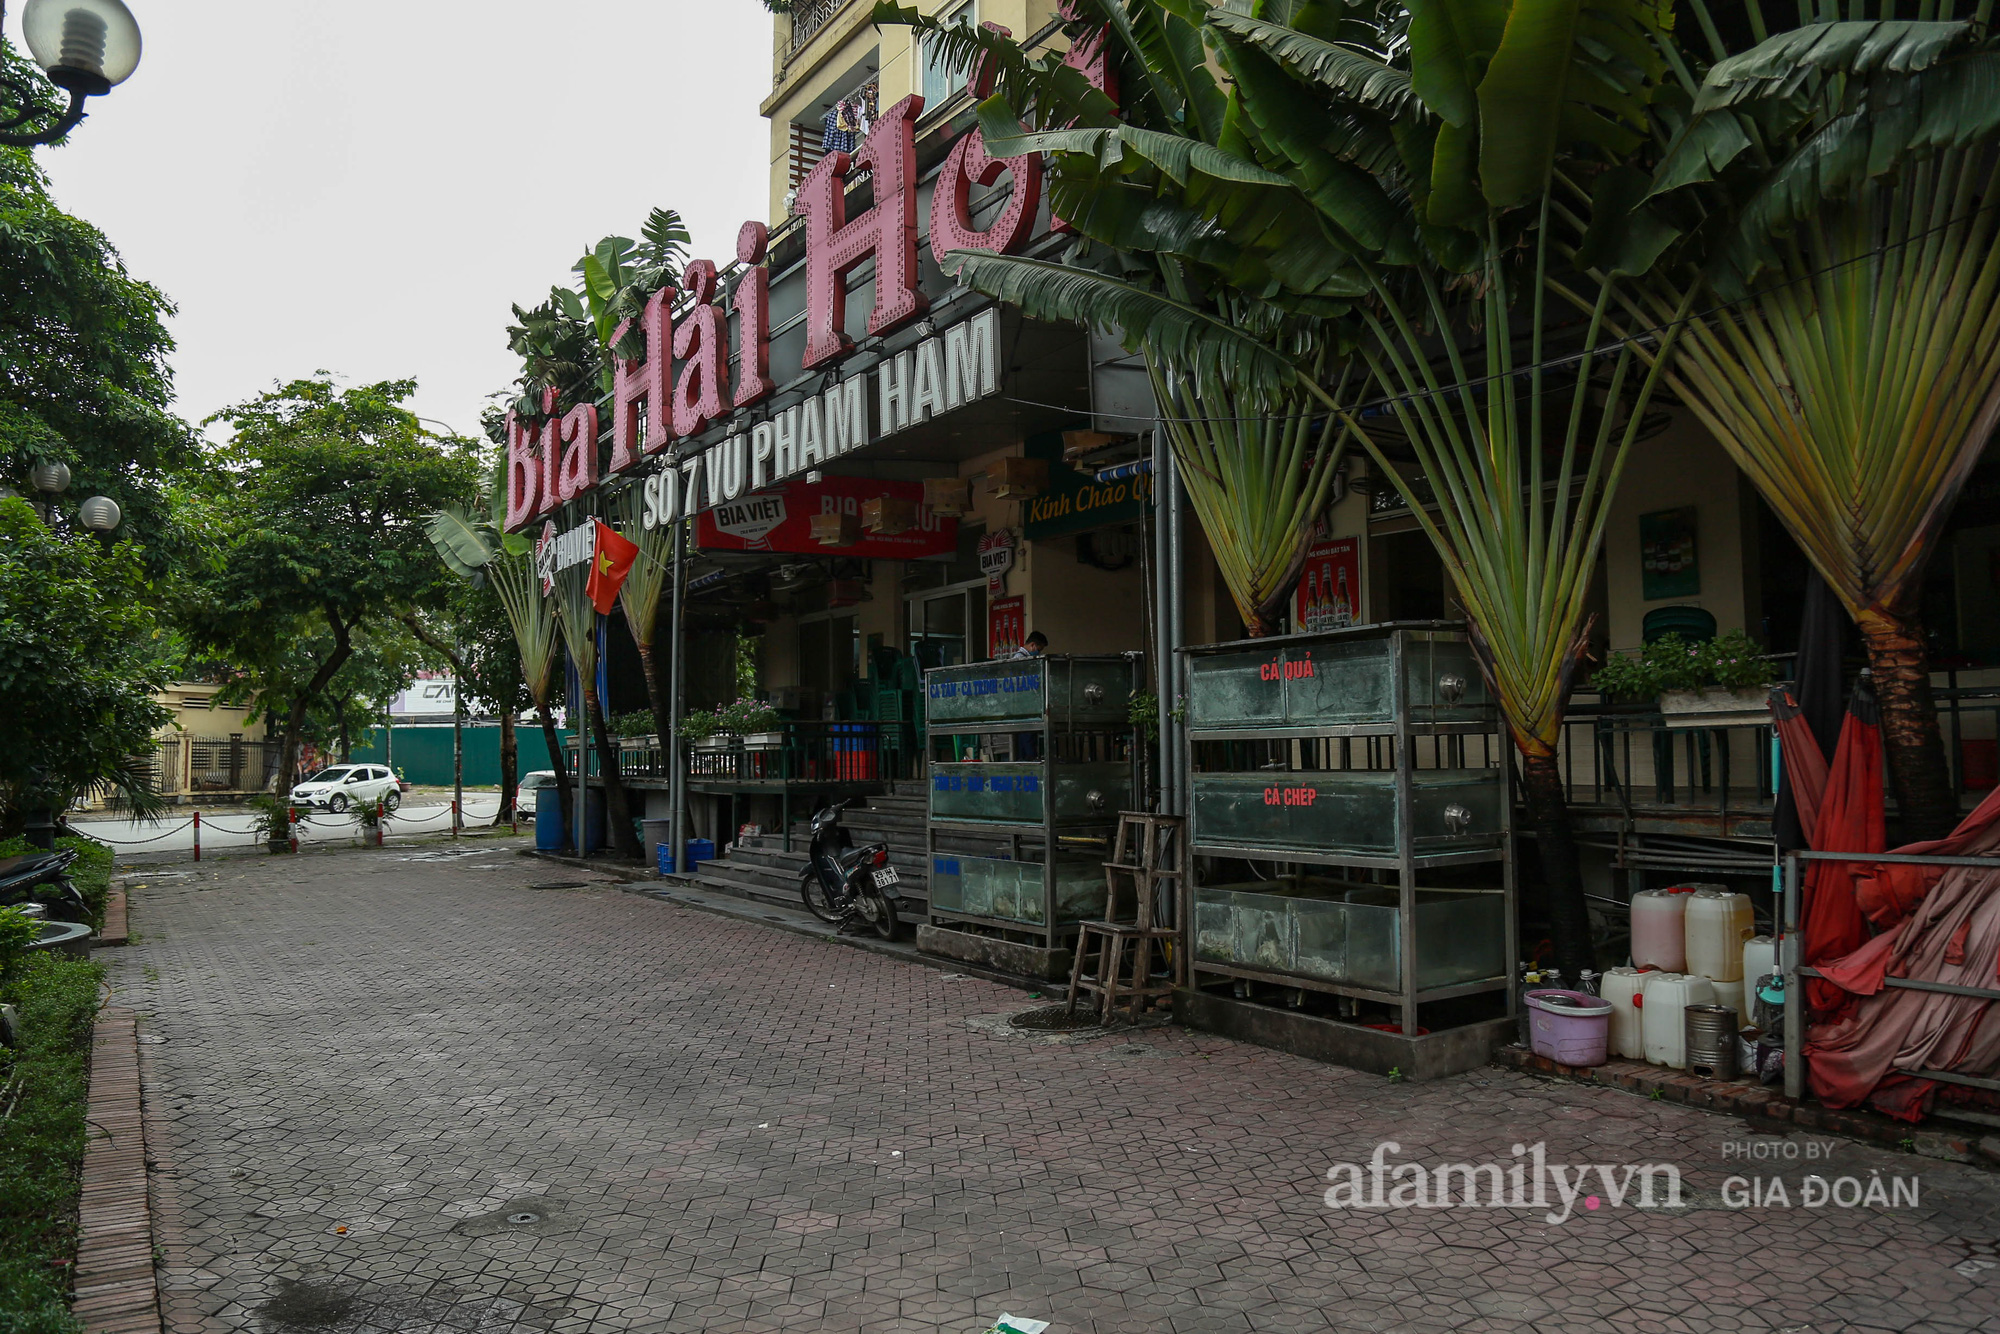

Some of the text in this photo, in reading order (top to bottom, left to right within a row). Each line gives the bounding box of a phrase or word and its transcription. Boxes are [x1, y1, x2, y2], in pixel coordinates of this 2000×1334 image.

[503, 387, 599, 533] Bia
[610, 221, 775, 473] Hải
[682, 456, 702, 516] 7
[705, 420, 748, 507] VŨ
[752, 373, 869, 484] PHẠM
[878, 307, 1000, 437] HÀM
[717, 497, 780, 526] BIA VIỆT
[1029, 492, 1071, 523] Kính
[1075, 481, 1126, 513] Chào
[981, 554, 993, 568] BIA
[1260, 651, 1314, 681] CÁ QUẢ
[1263, 782, 1317, 806] CÁ CHÉP
